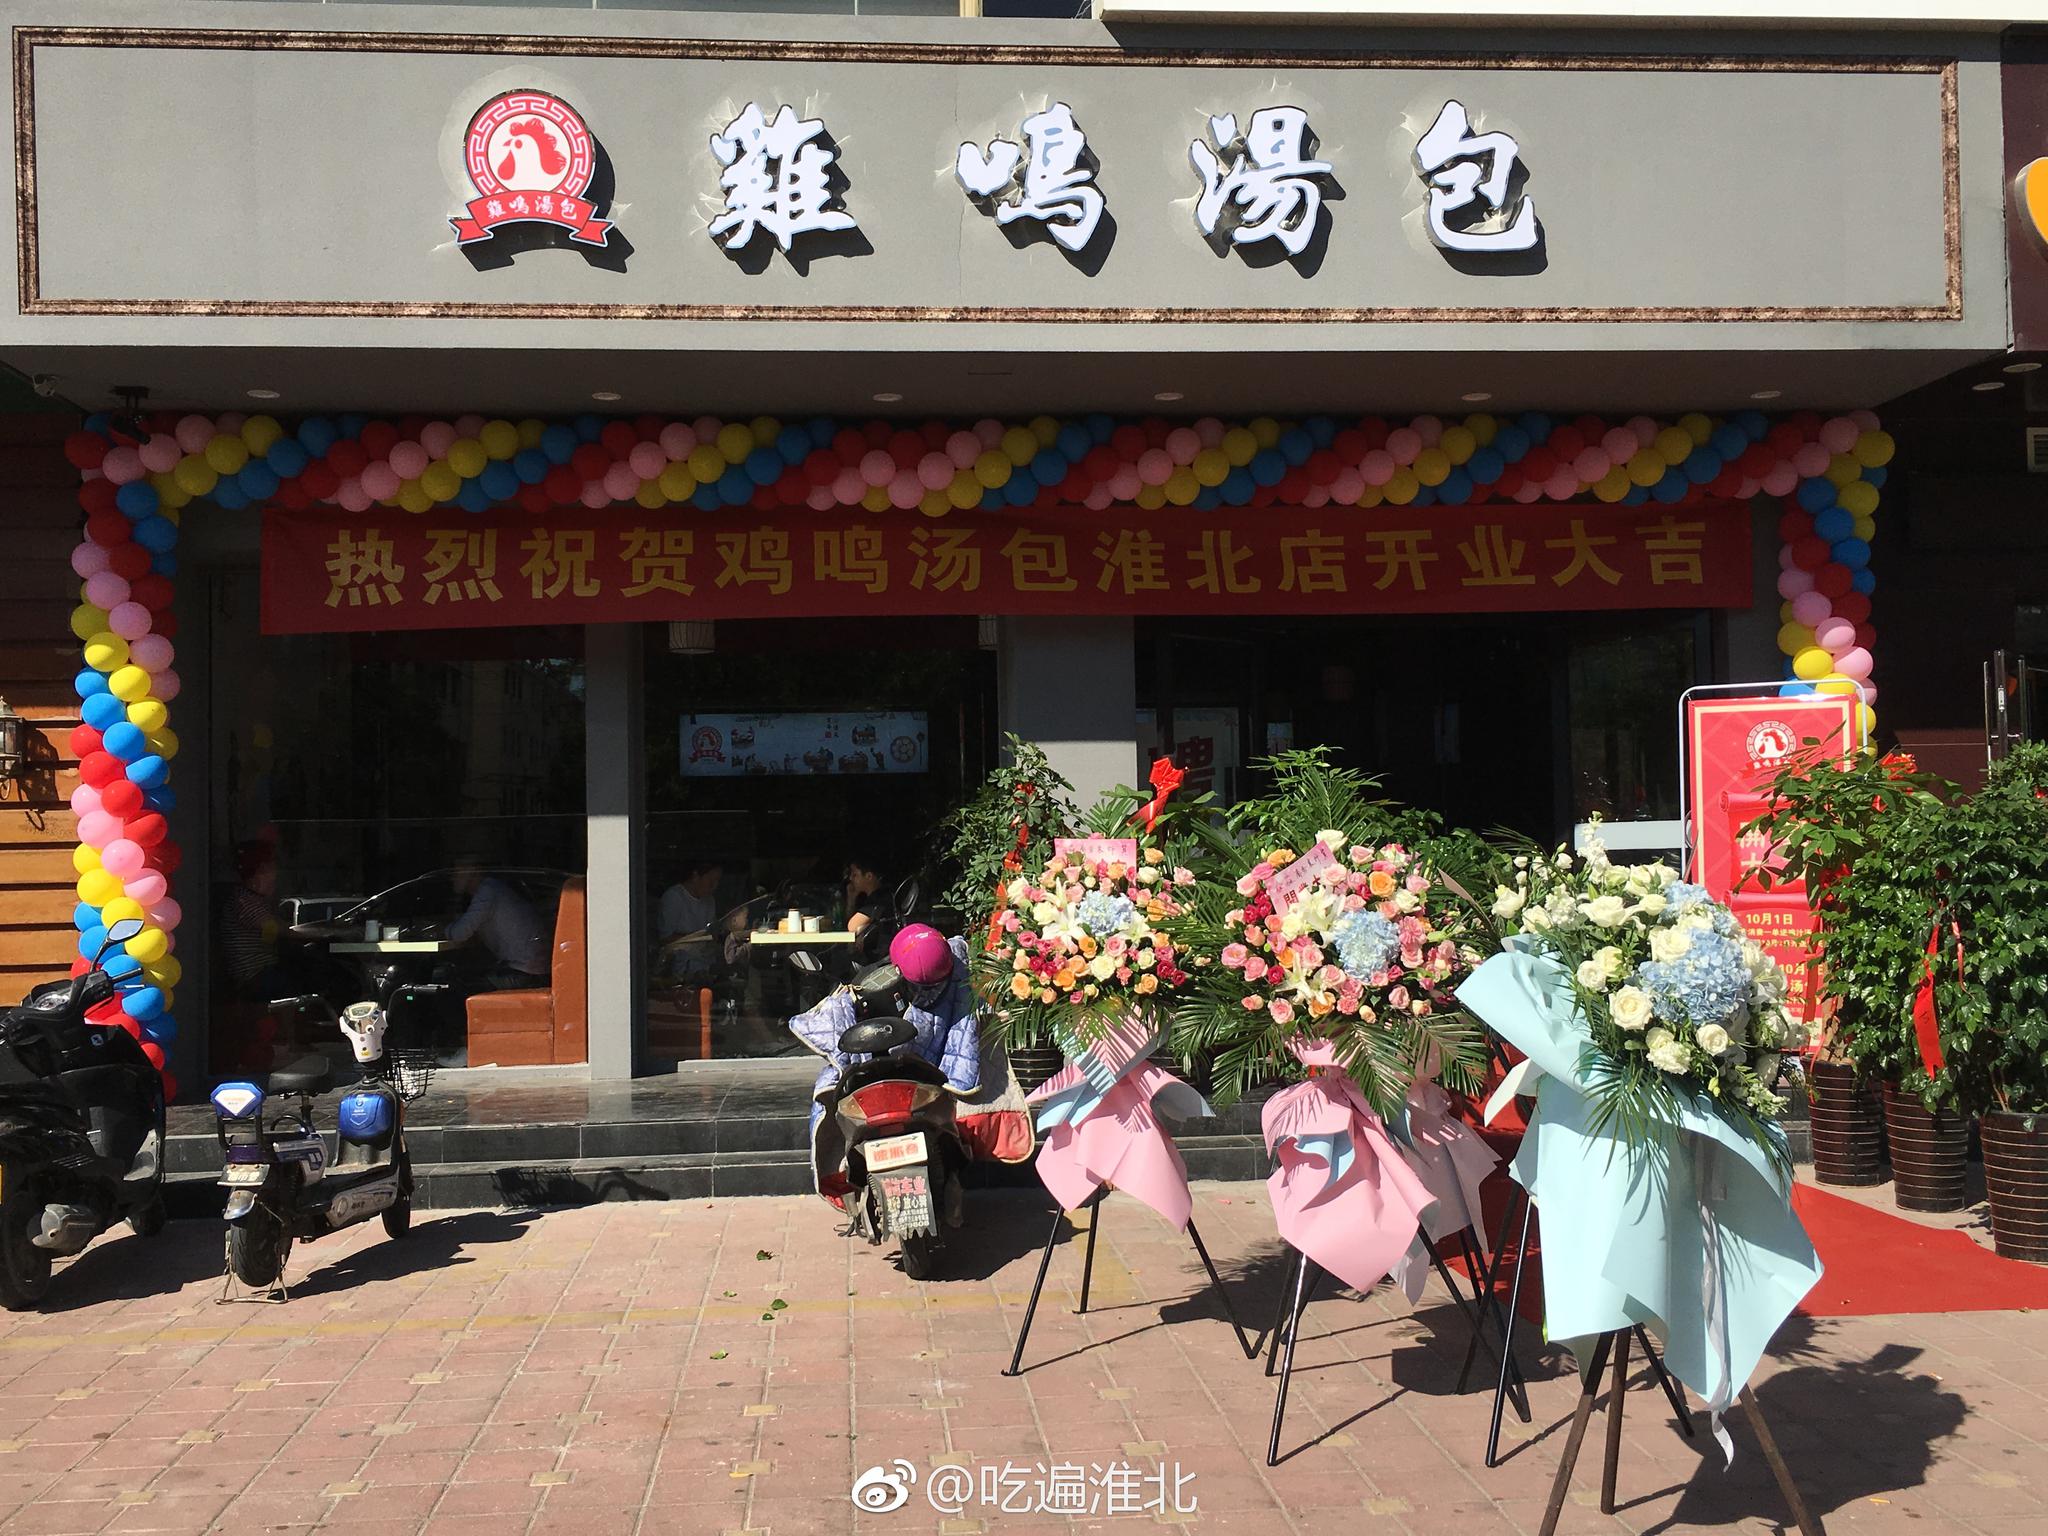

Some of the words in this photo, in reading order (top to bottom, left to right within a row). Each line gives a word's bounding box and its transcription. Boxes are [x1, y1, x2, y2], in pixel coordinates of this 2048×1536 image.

[324, 516, 1706, 609] 热烈祝贺鸡鸣汤包淮北店开业大吉
[1746, 913, 1792, 925] 10月1日
[1778, 963, 1823, 976] 10月日
